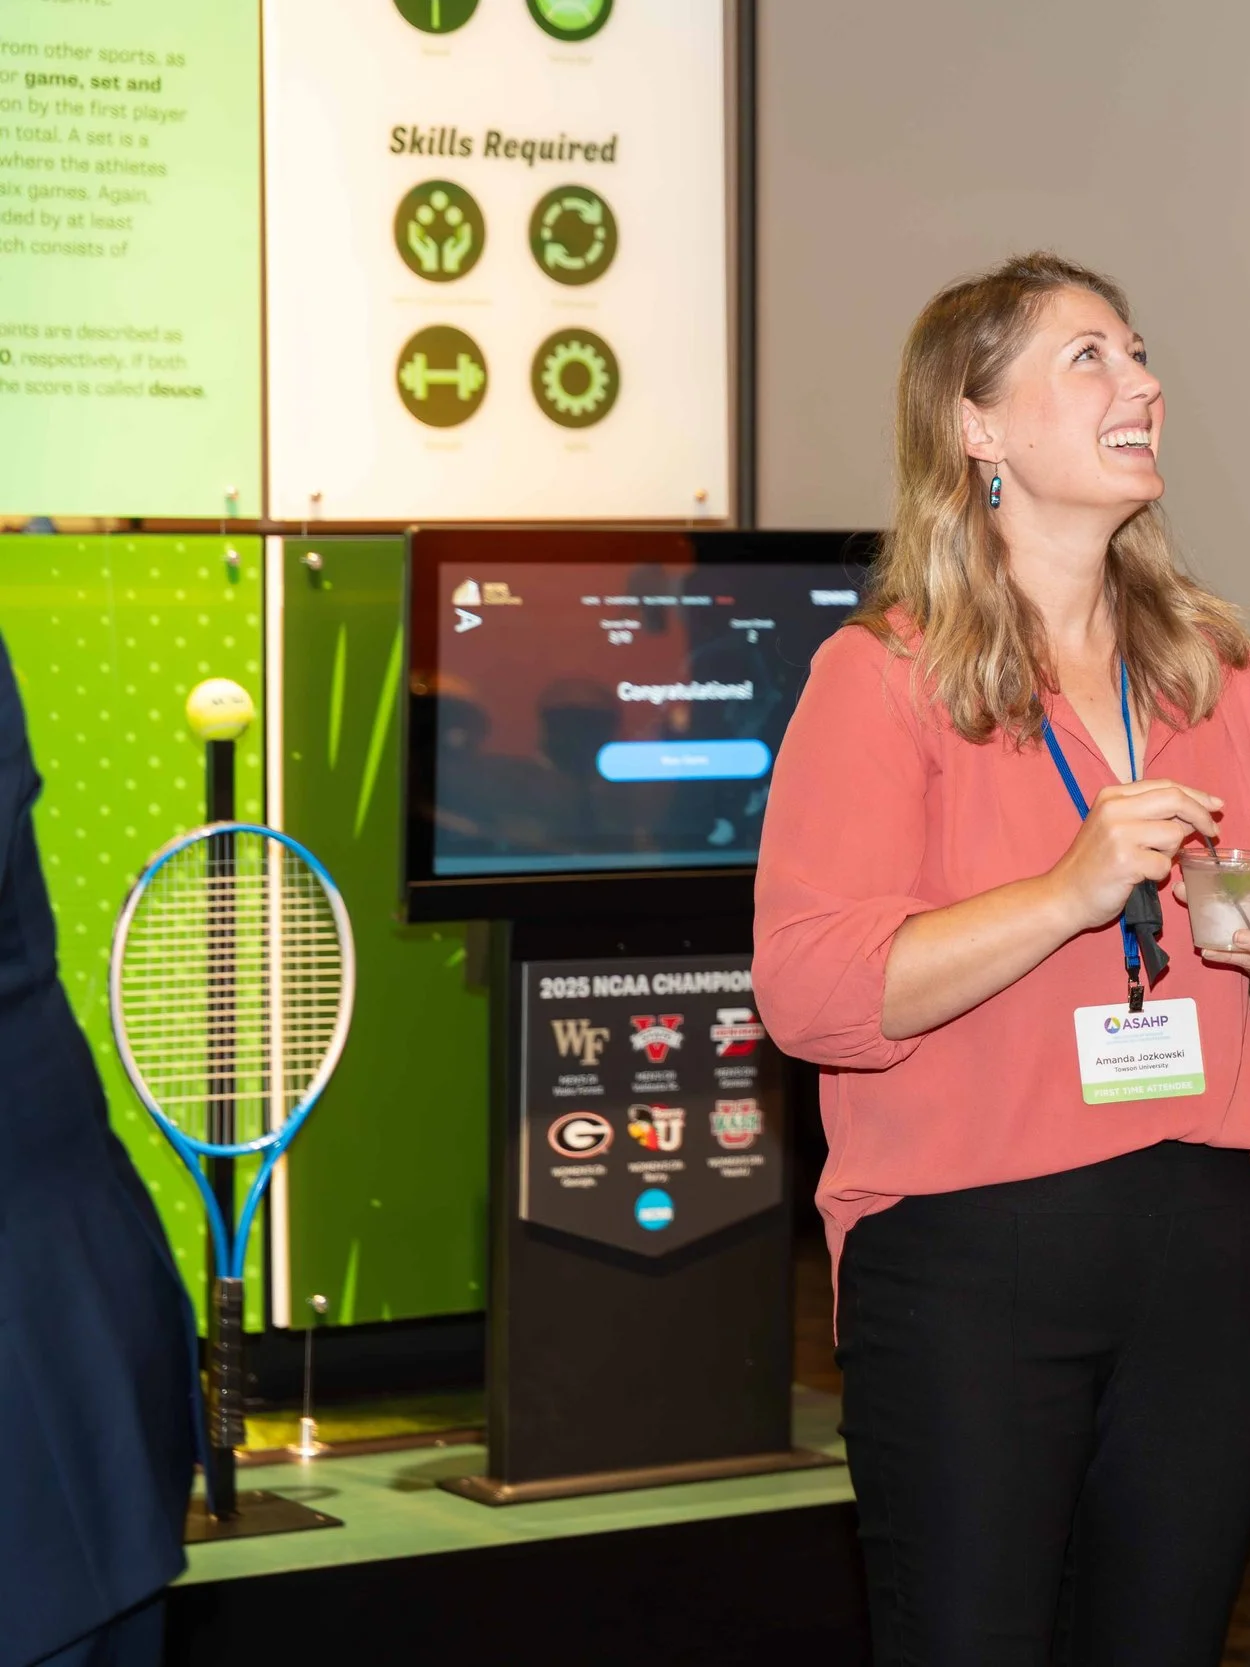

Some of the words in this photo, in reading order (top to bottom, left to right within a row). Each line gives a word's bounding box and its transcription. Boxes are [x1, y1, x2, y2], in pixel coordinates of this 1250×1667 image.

[44, 42, 92, 60] other
[165, 52, 186, 67] as
[24, 71, 85, 90] game,
[90, 75, 121, 91] set
[127, 76, 162, 93] and
[28, 98, 48, 118] by
[55, 99, 85, 117] the
[90, 100, 127, 120] first
[132, 104, 187, 125] player
[68, 127, 80, 142] A
[86, 131, 113, 146] set
[120, 133, 133, 147] is
[139, 135, 149, 148] a
[389, 125, 474, 158] Skills
[482, 129, 619, 168] Required
[0, 152, 55, 170] where
[60, 156, 90, 173] the
[95, 158, 168, 177] athletes
[40, 209, 61, 231] by
[67, 213, 85, 228] at
[91, 212, 133, 230] least
[30, 240, 104, 257] consists
[109, 239, 129, 258] of
[45, 325, 72, 339] are
[77, 324, 158, 341] described
[164, 329, 183, 344] as
[148, 355, 187, 370] both
[25, 380, 72, 396] score
[78, 381, 90, 396] is
[95, 379, 143, 397] called
[539, 976, 590, 1000] 2025
[592, 974, 650, 997] NCAA
[1122, 1015, 1169, 1030] ASAHP
[1095, 1054, 1135, 1066] Amanda
[1138, 1049, 1185, 1062] Jozkowski
[1139, 1062, 1169, 1072] University
[1094, 1088, 1120, 1098] FIRST
[1122, 1086, 1144, 1096] TIME
[1146, 1080, 1194, 1093] ATTENDEE
